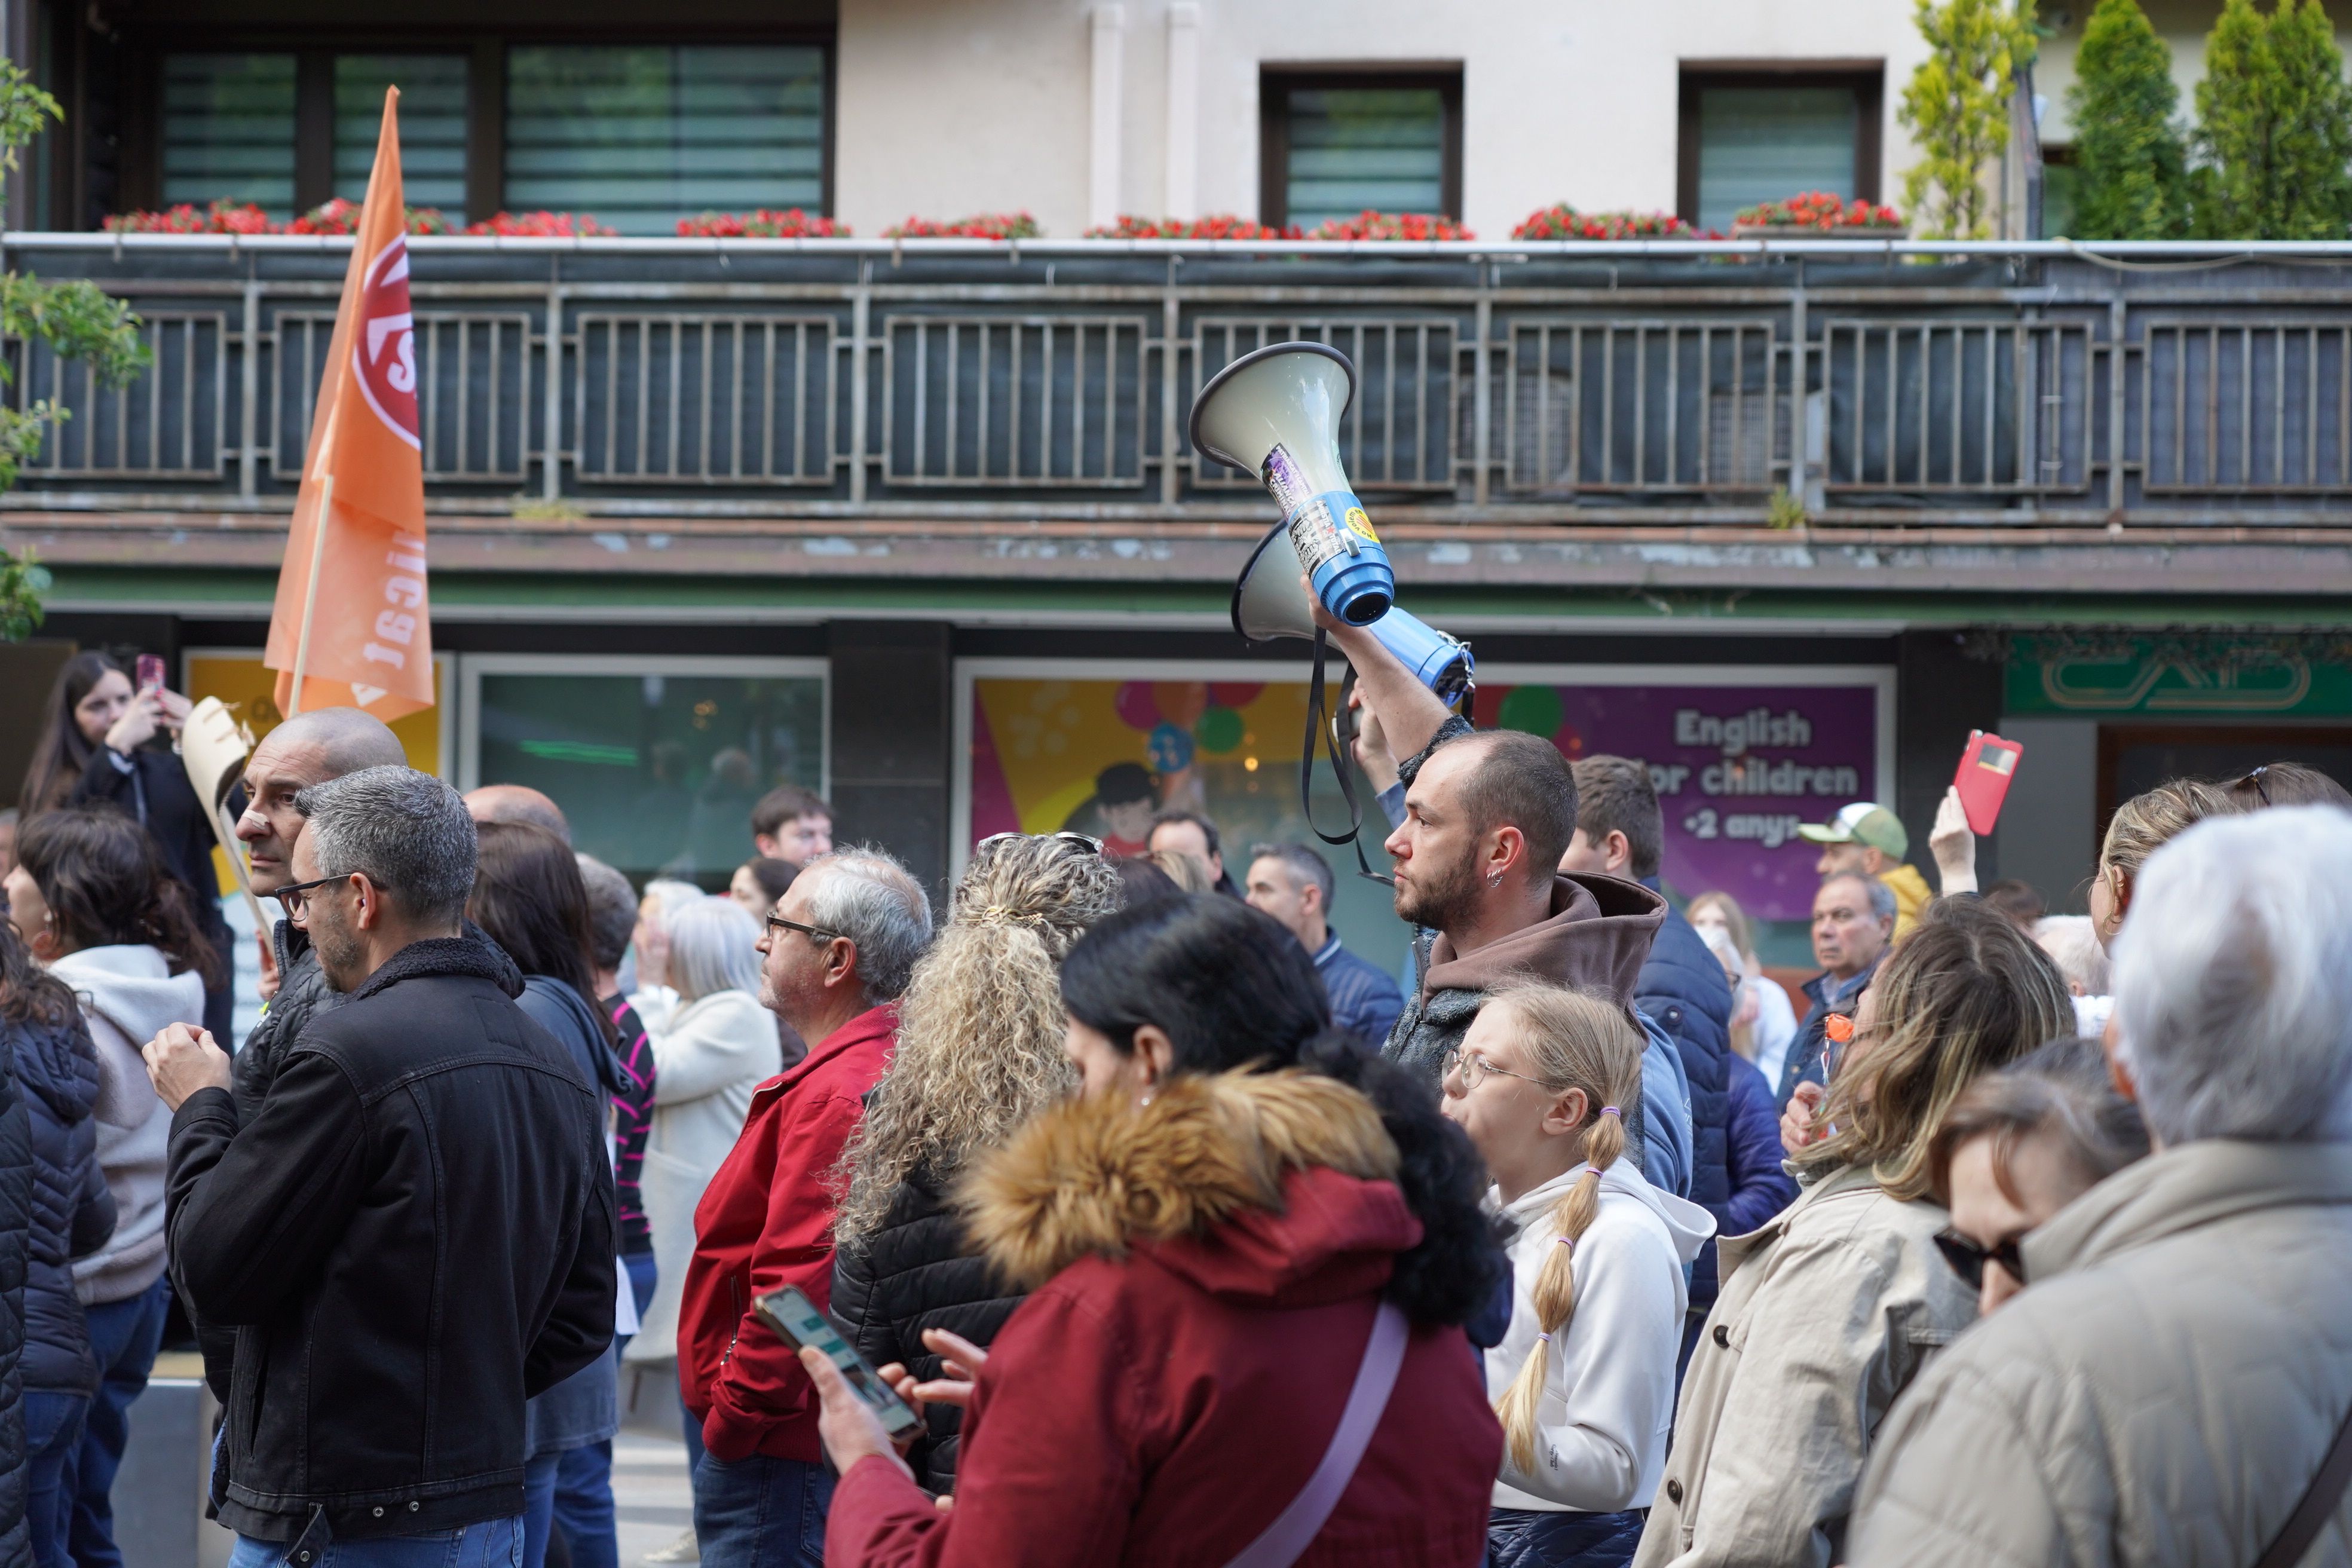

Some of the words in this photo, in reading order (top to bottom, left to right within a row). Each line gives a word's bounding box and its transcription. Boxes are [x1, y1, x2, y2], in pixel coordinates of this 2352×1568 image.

[1276, 445, 1298, 474] PATRIARCAT
[1297, 476, 1310, 495] CAPITAL
[1270, 479, 1291, 516] CRIMINAL
[1316, 500, 1331, 528] AMNISTIA
[1348, 511, 1360, 531] volem
[1362, 529, 1373, 539] Ho
[1675, 707, 1812, 757] English
[1644, 761, 1690, 796] or
[1700, 756, 1860, 797] children
[1725, 813, 1801, 849] anys
